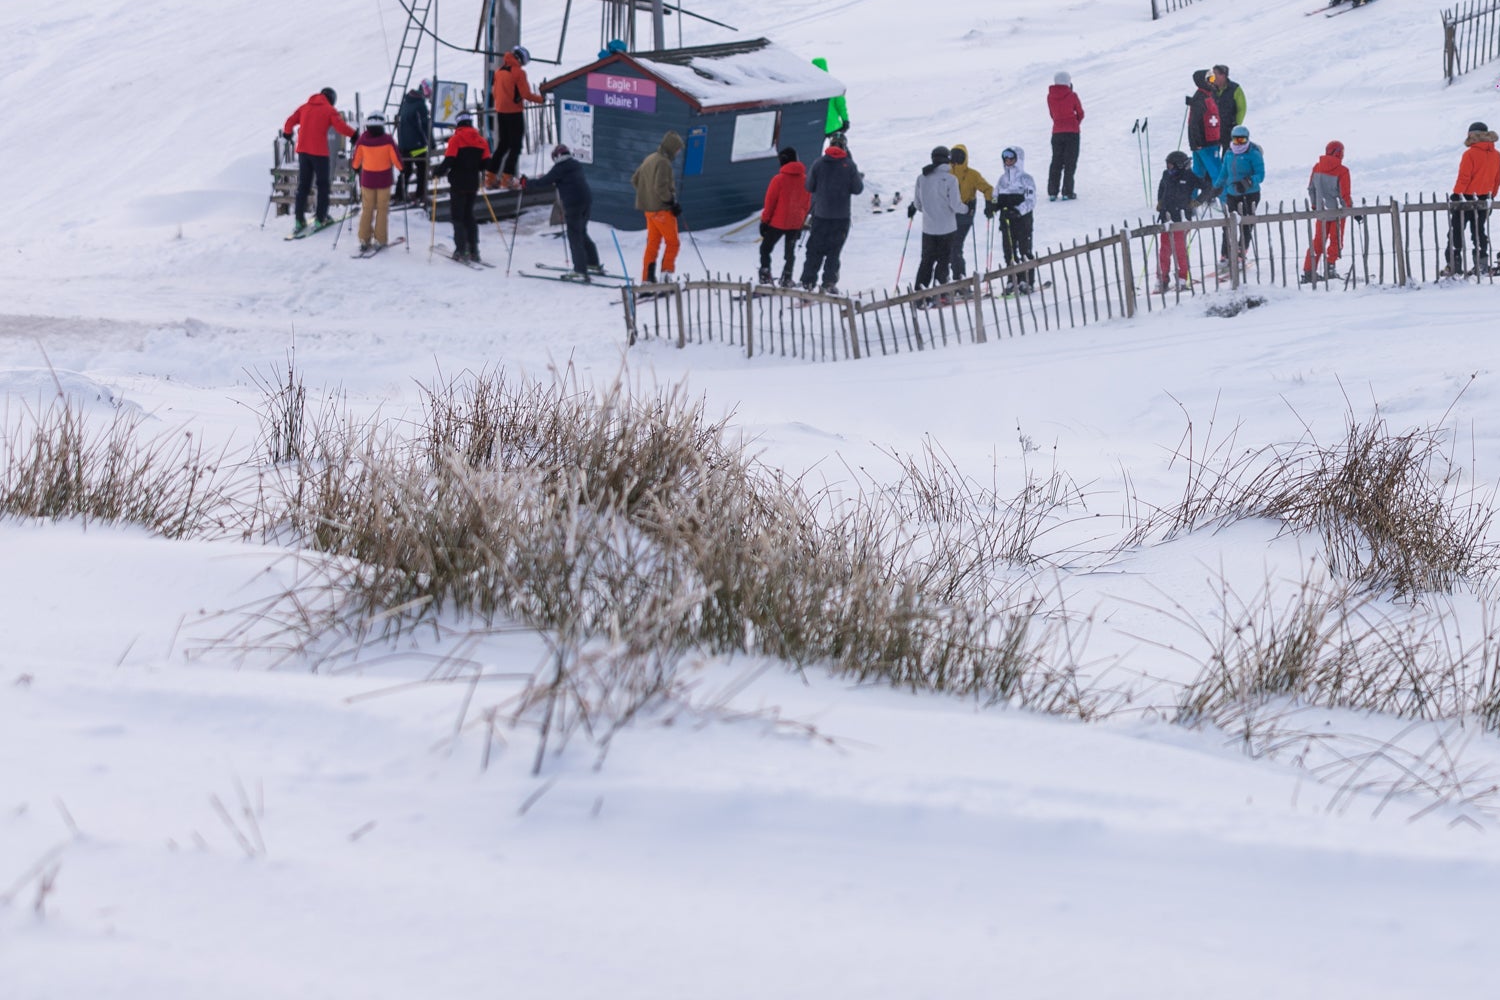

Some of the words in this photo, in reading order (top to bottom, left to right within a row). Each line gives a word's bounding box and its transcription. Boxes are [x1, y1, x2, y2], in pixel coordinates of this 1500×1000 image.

[607, 77, 631, 92] Eagle
[633, 81, 637, 91] 1
[605, 94, 632, 108] Iolaire
[634, 97, 638, 108] 1
